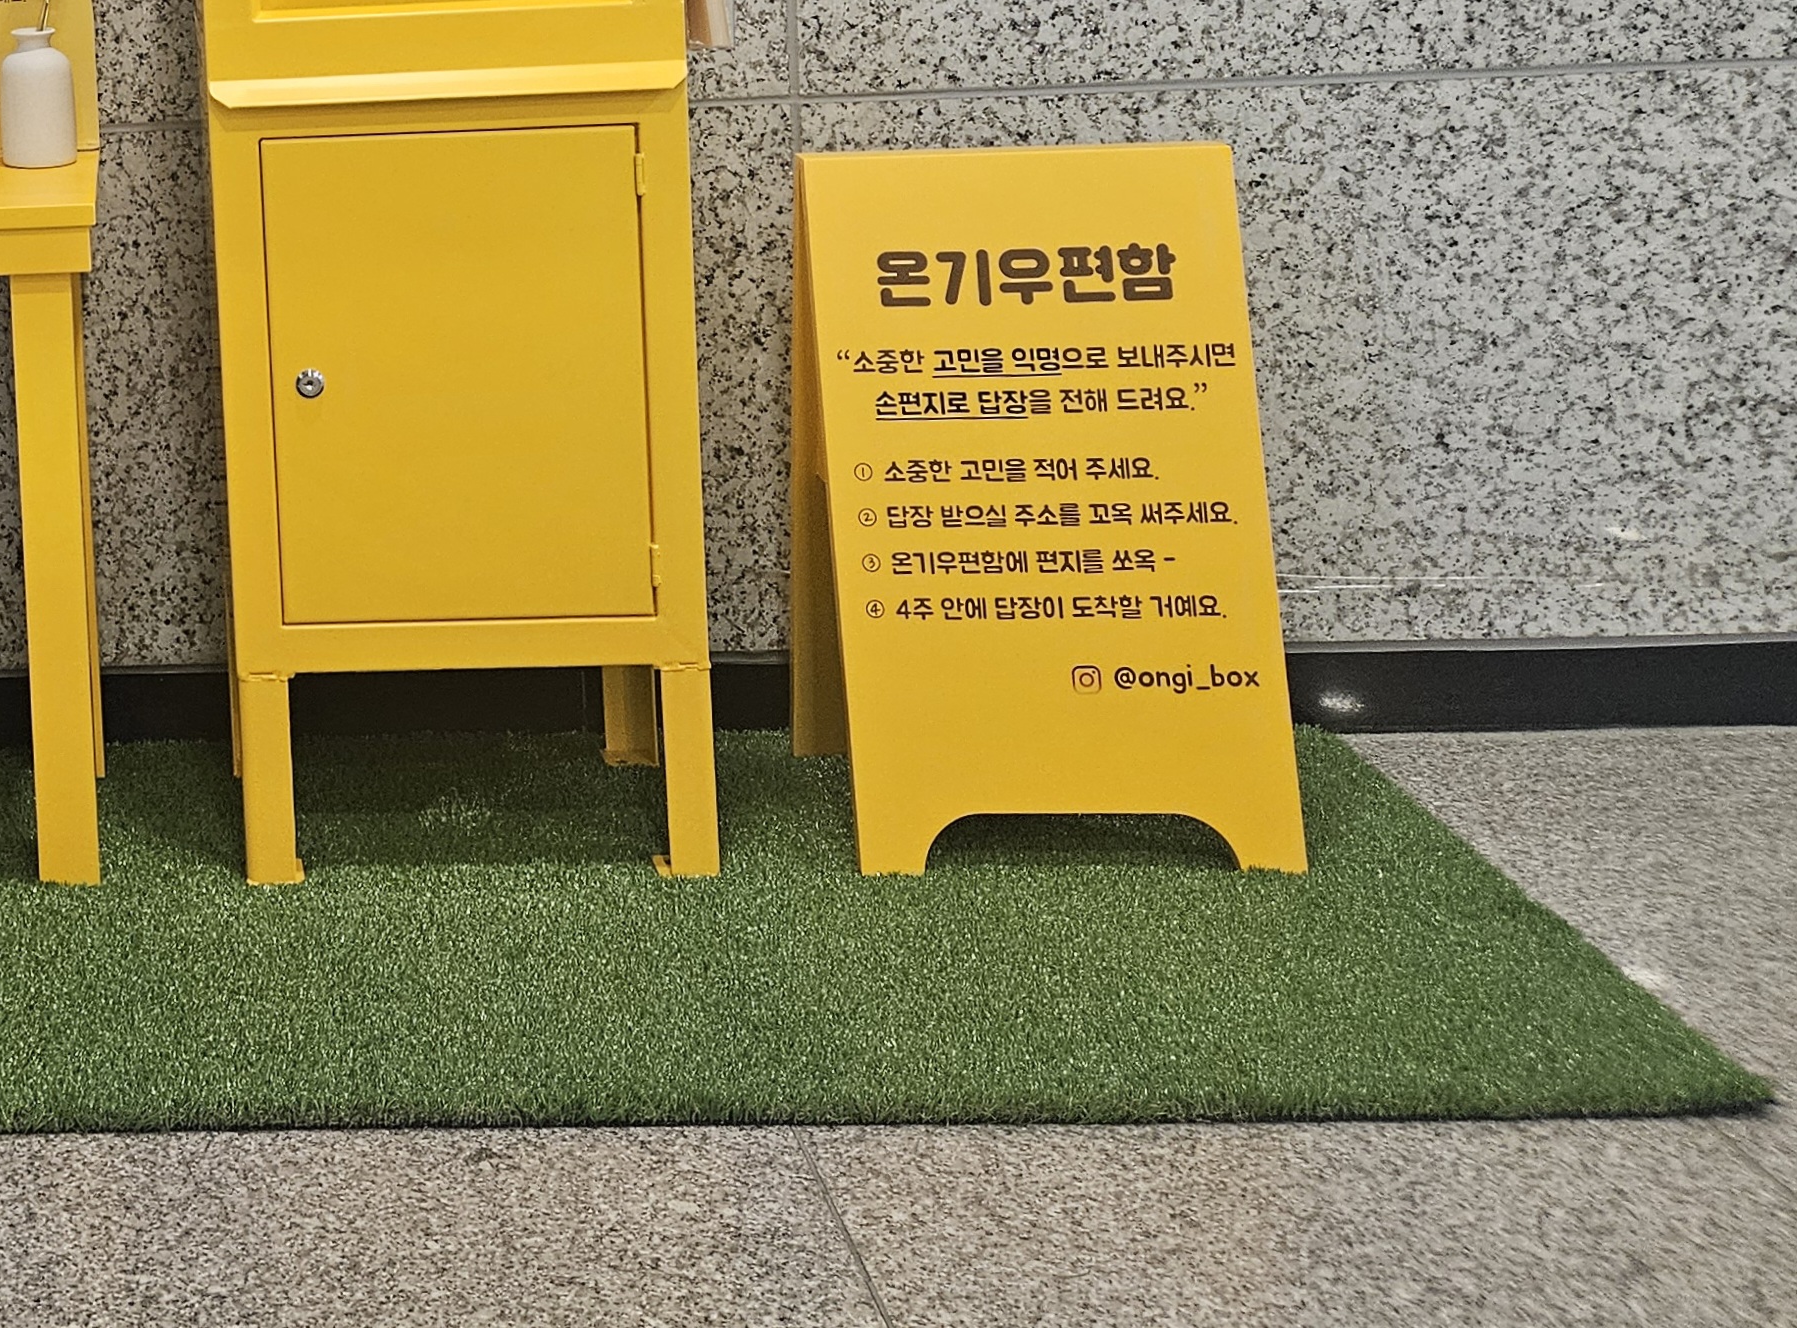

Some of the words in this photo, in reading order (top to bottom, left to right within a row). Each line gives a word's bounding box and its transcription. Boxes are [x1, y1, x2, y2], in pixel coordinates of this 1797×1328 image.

[875, 242, 1177, 308] 온기우편함
[933, 348, 1004, 374] 고민을
[1011, 346, 1109, 373] 익명으로
[1116, 343, 1236, 369] 보내주시면
[875, 391, 970, 416] 손편지로
[977, 389, 1052, 416] 답장을
[1059, 387, 1108, 414] 전해
[884, 459, 952, 483] 소중한
[960, 459, 1027, 483] 고민을
[1033, 457, 1079, 482] 적어
[1085, 456, 1160, 481] 주세요.
[886, 505, 933, 529] 답장
[940, 504, 1007, 528] 받으실
[1014, 503, 1081, 527] 주소를
[1088, 502, 1132, 526] 꼬옥
[1140, 501, 1238, 525] 써주세요.
[891, 550, 1029, 575] 온기우편함에
[1036, 549, 1104, 574] 편지를
[1111, 549, 1155, 572] 쏘옥
[895, 597, 935, 622] 4주
[941, 596, 987, 621] 안에
[995, 595, 1064, 620] 답장이
[1072, 595, 1141, 619] 도착할
[1149, 595, 1227, 618] 거예요.
[1114, 665, 1260, 693] @ongi_box
